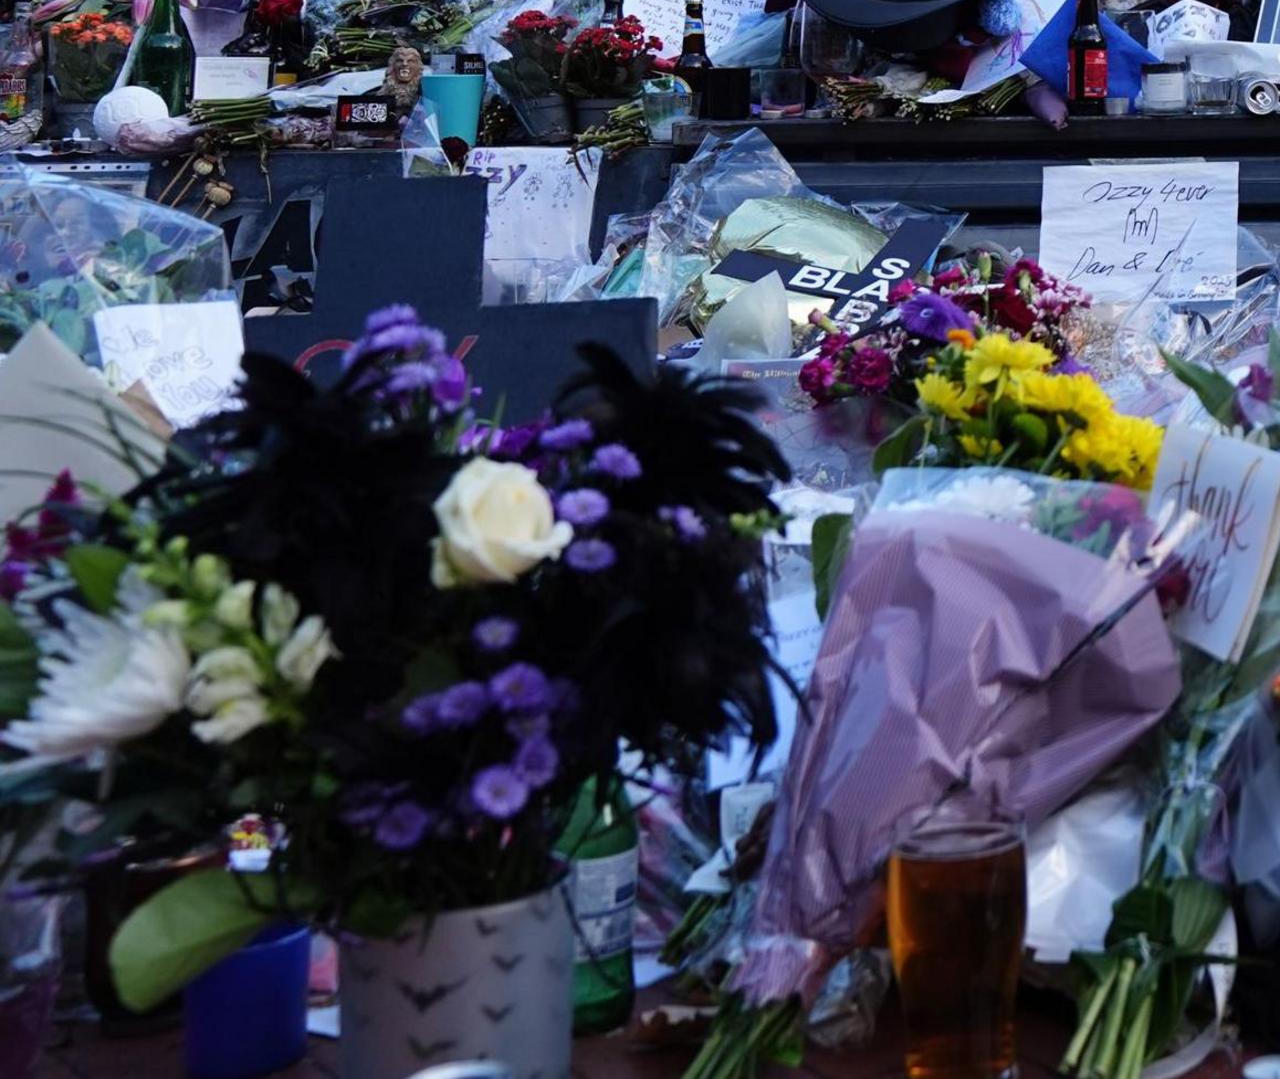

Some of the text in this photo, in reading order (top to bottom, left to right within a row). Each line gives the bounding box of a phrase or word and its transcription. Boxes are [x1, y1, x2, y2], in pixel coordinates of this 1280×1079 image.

[464, 164, 528, 195] ZZY
[1083, 178, 1216, 210] Ozzy 4ever
[1066, 246, 1115, 281] Dan
